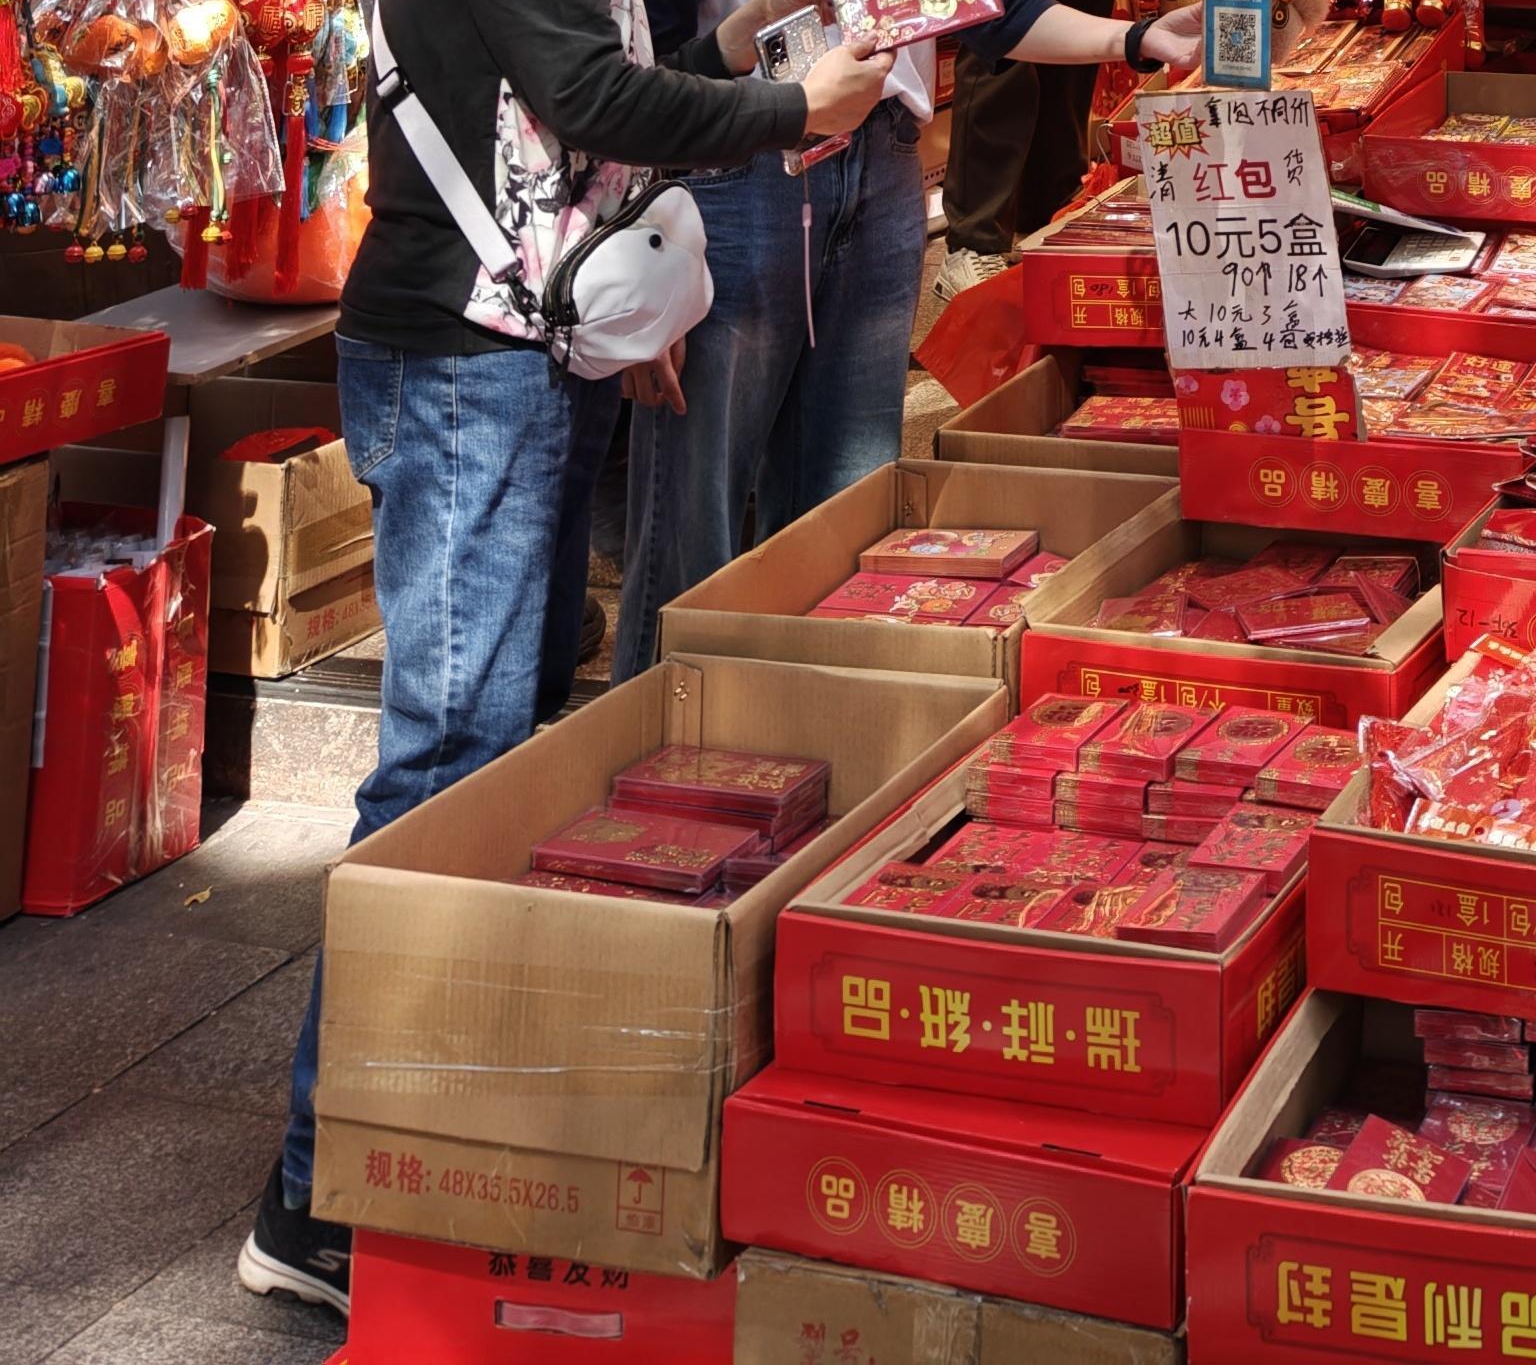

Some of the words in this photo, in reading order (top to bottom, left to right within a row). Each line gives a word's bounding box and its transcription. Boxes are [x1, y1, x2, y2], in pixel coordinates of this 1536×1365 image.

[1149, 117, 1202, 148] 超值
[1192, 158, 1277, 202] 红包
[1165, 212, 1328, 260] 10元5盒
[1072, 277, 1087, 297] 包
[1072, 306, 1088, 326] 开
[1113, 306, 1146, 327] 规格
[0, 379, 117, 429] 喜慶精
[1259, 467, 1443, 512] 喜慶精品
[1082, 670, 1102, 696] 包
[1380, 878, 1405, 915] 包
[1454, 891, 1491, 926] 1盒
[1379, 928, 1405, 962] 开
[1448, 939, 1502, 979] 规格
[364, 1148, 434, 1197] 规格:
[438, 1169, 581, 1216] 48X35.5X26.5
[818, 1172, 1063, 1261] 喜慶精品
